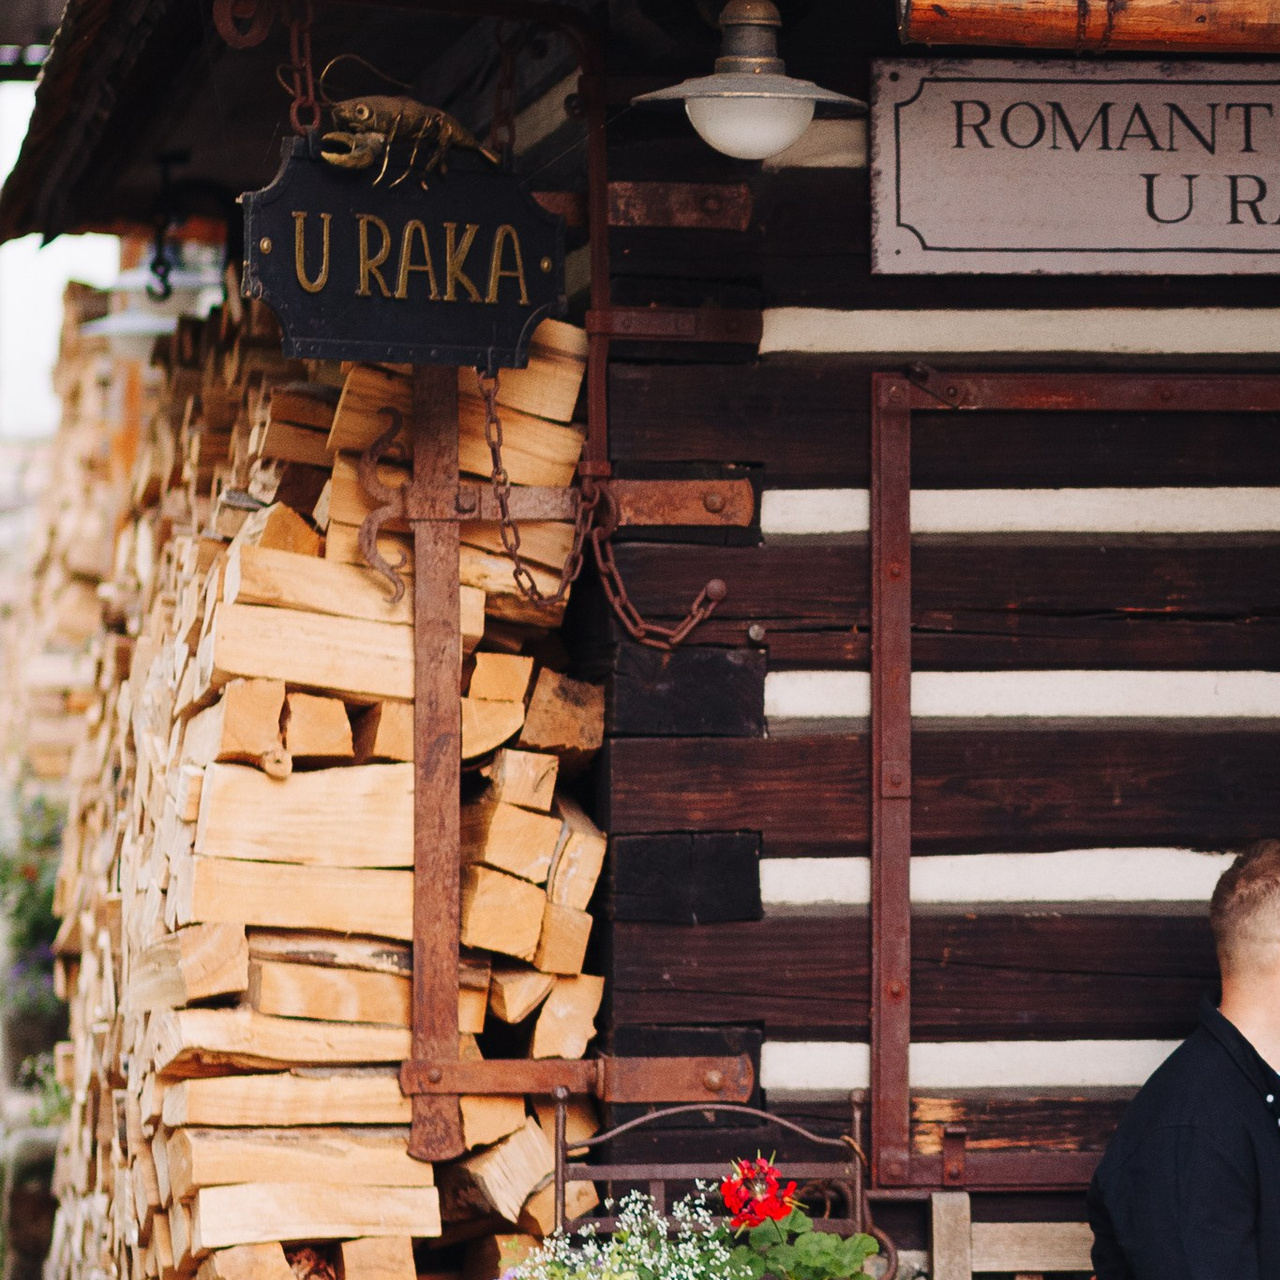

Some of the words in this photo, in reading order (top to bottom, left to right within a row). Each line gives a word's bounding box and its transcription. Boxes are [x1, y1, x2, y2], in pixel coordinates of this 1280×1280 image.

[1138, 172, 1199, 226] U
[291, 210, 332, 294] U
[355, 213, 530, 306] RAKA
